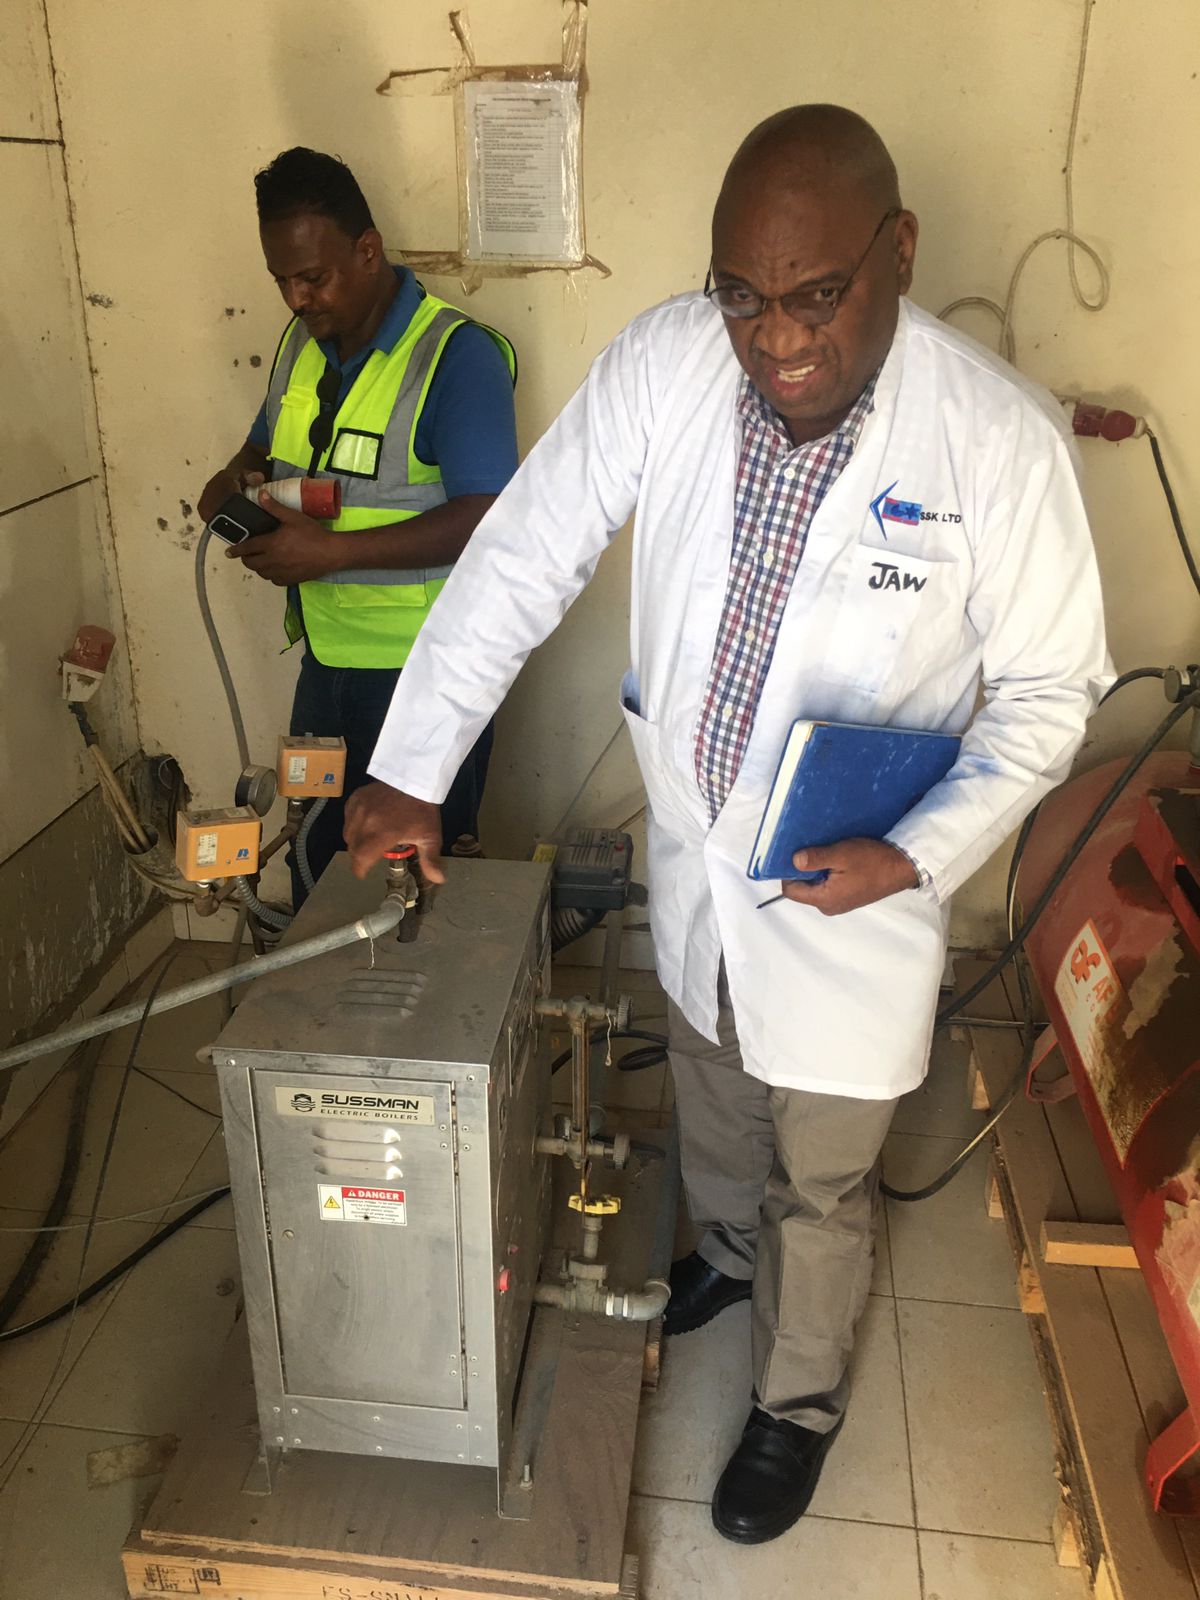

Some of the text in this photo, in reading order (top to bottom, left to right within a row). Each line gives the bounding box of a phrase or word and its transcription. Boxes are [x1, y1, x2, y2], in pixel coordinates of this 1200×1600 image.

[920, 511, 962, 524] SSK LTD
[868, 561, 928, 593] JAW
[321, 1094, 419, 1110] SUSSMAN
[320, 1108, 419, 1121] ELECTRIC BOILERS
[358, 1190, 400, 1200] DANGER
